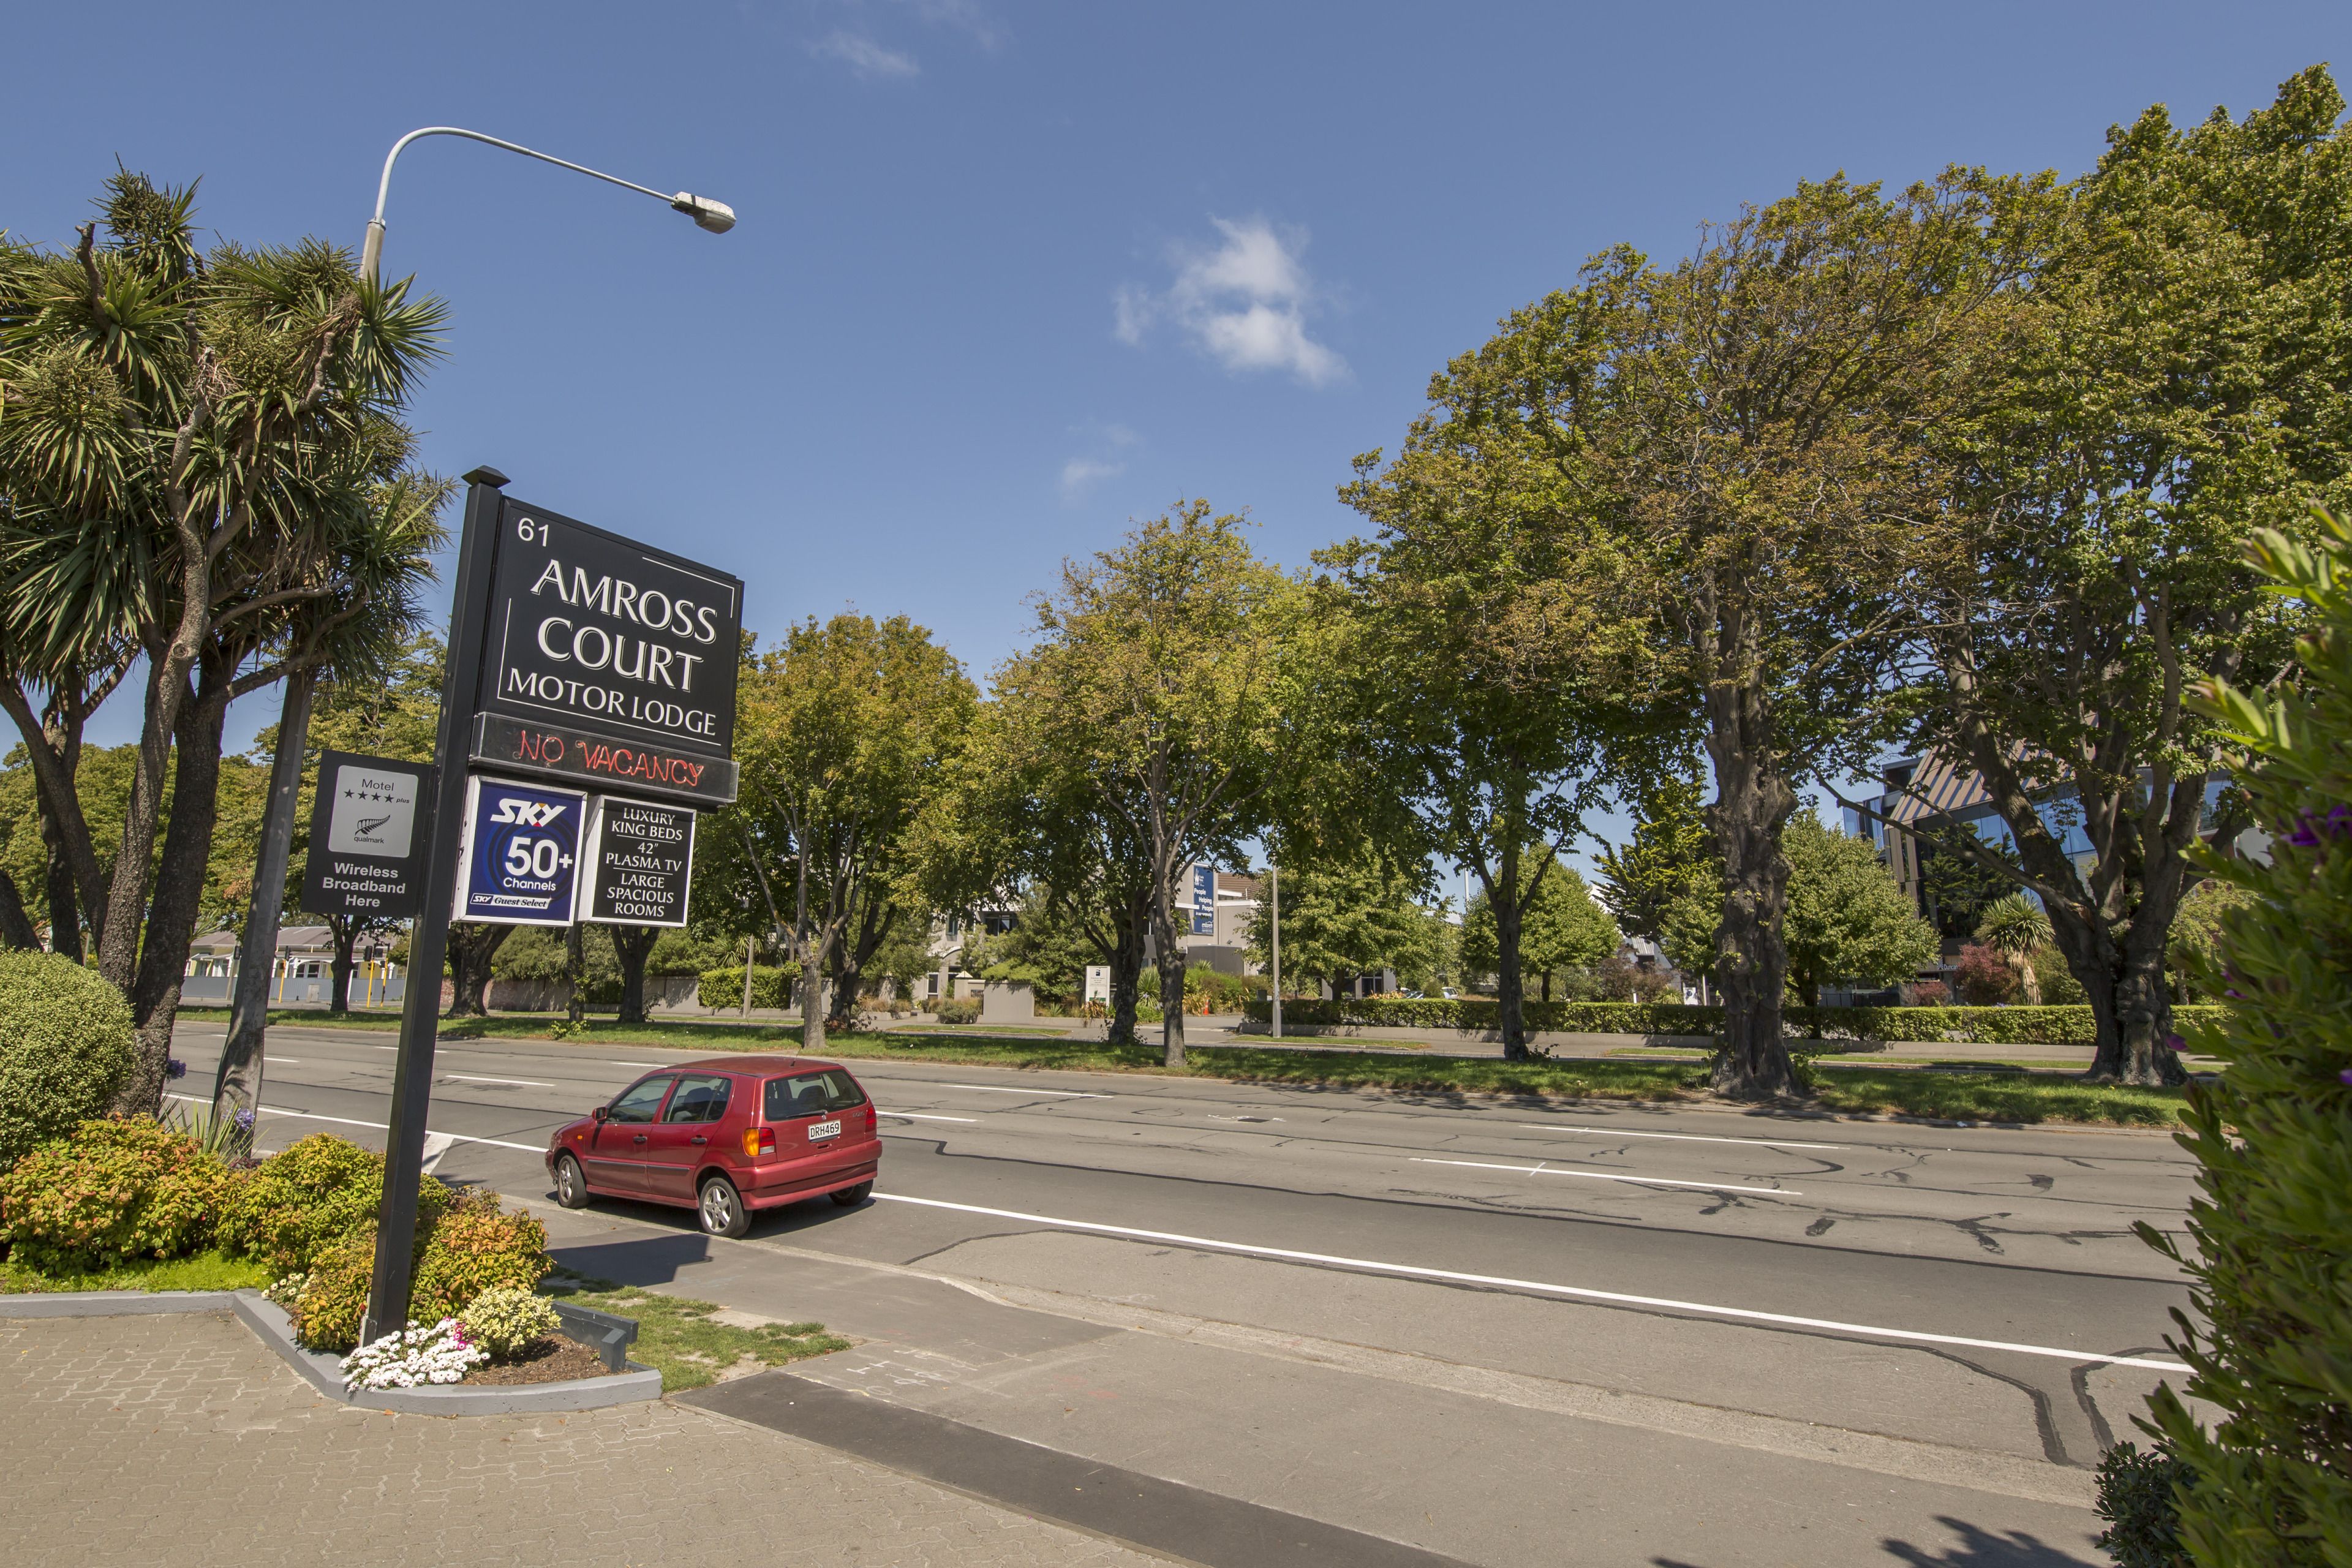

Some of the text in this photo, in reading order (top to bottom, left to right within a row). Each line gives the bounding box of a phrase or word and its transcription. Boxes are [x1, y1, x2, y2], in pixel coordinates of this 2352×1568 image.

[518, 518, 549, 546] 61
[530, 559, 717, 644] AMROSS
[537, 617, 704, 693] COURT
[507, 668, 717, 736] MOTOR LODGE
[518, 730, 704, 787] NO VACANCY
[362, 778, 394, 791] Motel
[490, 798, 567, 827] SKY
[623, 807, 675, 826] LUXURY
[612, 821, 683, 840] KING BEDS
[353, 835, 385, 844] qualmark
[334, 862, 398, 878] Wireless
[606, 853, 682, 872] PLASMA TV
[322, 877, 406, 894] Broadband
[503, 876, 556, 892] Channels
[621, 873, 665, 889] LARGE
[345, 894, 380, 908] Here
[494, 897, 520, 905] Guest
[521, 899, 547, 907] Select
[607, 887, 674, 903] SPACIOUS
[614, 902, 665, 917] ROOMS
[810, 1123, 839, 1137] DRH469
